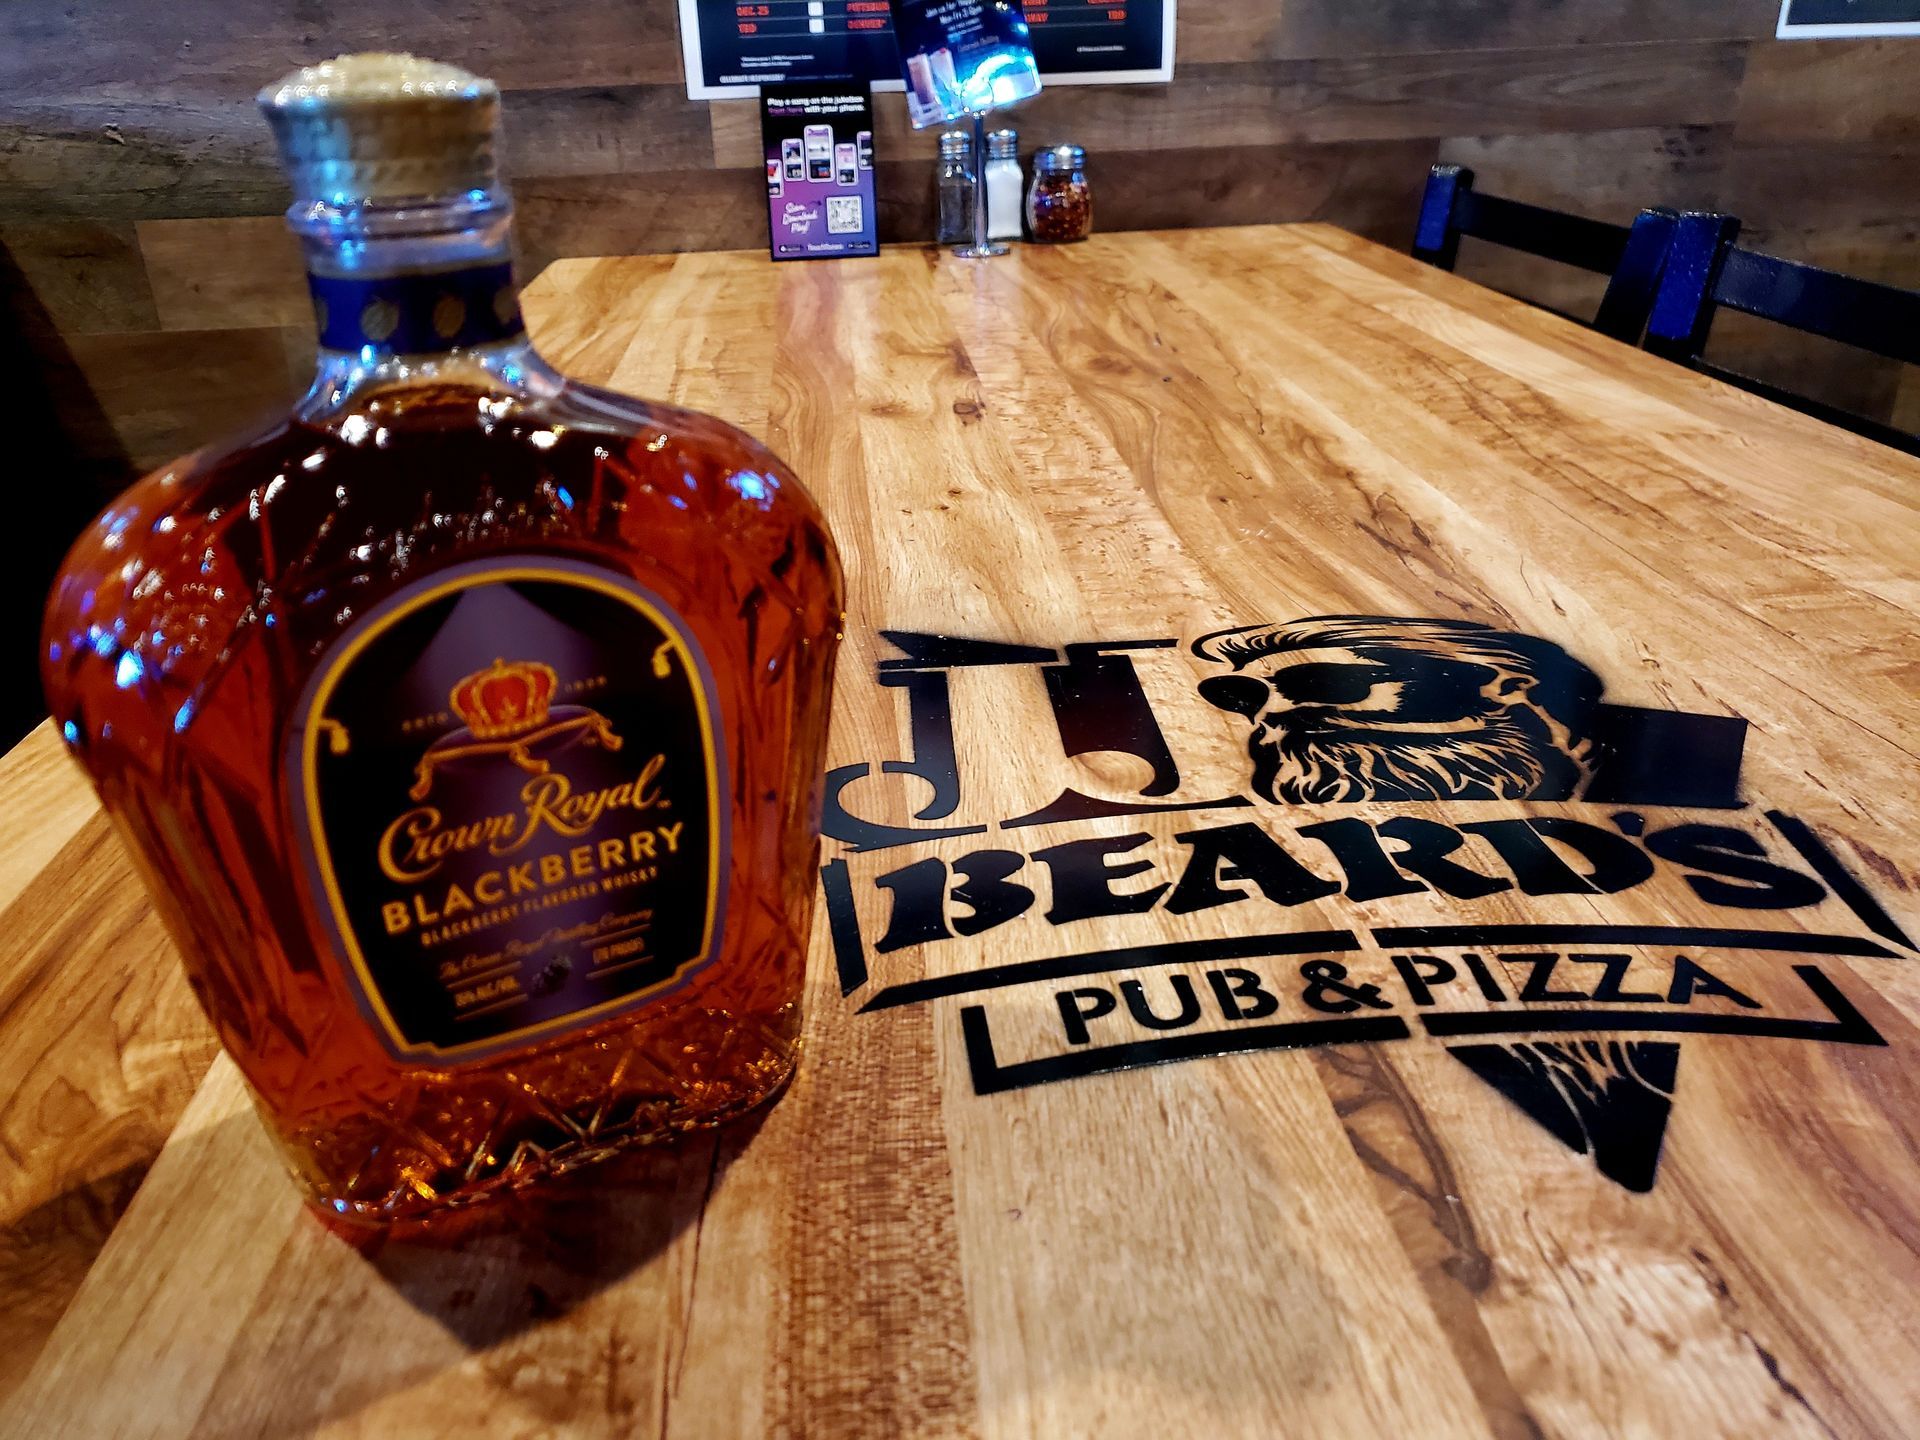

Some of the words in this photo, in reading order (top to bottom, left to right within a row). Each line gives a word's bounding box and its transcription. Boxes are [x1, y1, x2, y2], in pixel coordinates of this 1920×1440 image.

[767, 97, 784, 107] Play
[791, 98, 809, 107] song
[821, 96, 833, 105] the
[804, 105, 820, 113] with
[821, 105, 838, 114] your
[378, 806, 517, 884] Crown
[489, 753, 666, 858] Royal
[381, 821, 684, 936] BLACKBERRY
[421, 904, 519, 947] BLACKBERRY
[601, 865, 658, 892] WHISKY
[875, 811, 1828, 954] BEARD'S
[1055, 967, 1279, 1045] PUB
[1300, 959, 1395, 1013] &
[1391, 953, 1763, 1010] PIZZA
